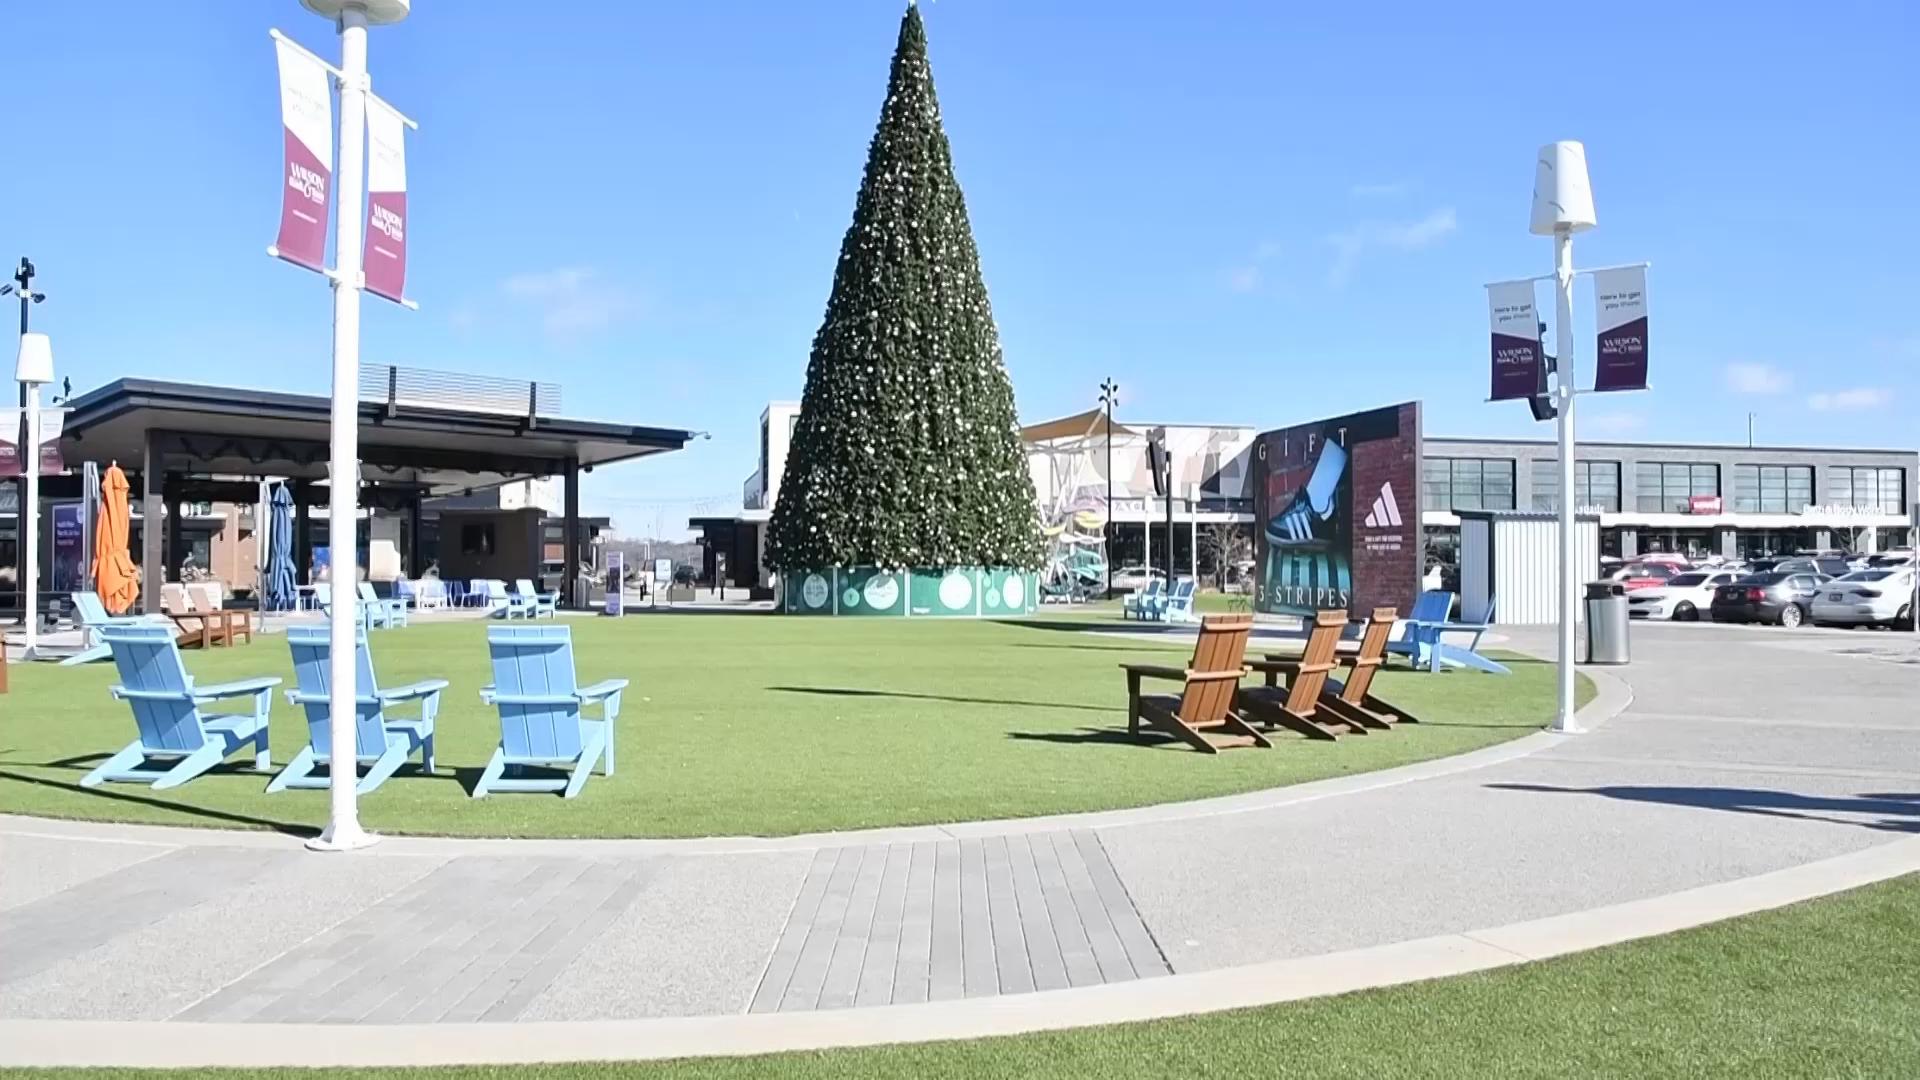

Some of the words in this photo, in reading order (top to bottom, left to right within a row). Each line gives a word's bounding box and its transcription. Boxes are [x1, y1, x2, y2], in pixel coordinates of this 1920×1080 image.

[291, 162, 325, 193] WILSON
[373, 203, 403, 231] WILSON
[1498, 347, 1532, 358] WILSON
[1604, 336, 1641, 347] WILSON
[1258, 427, 1347, 461] GIFT
[1258, 585, 1348, 608] 3-STRIPES
